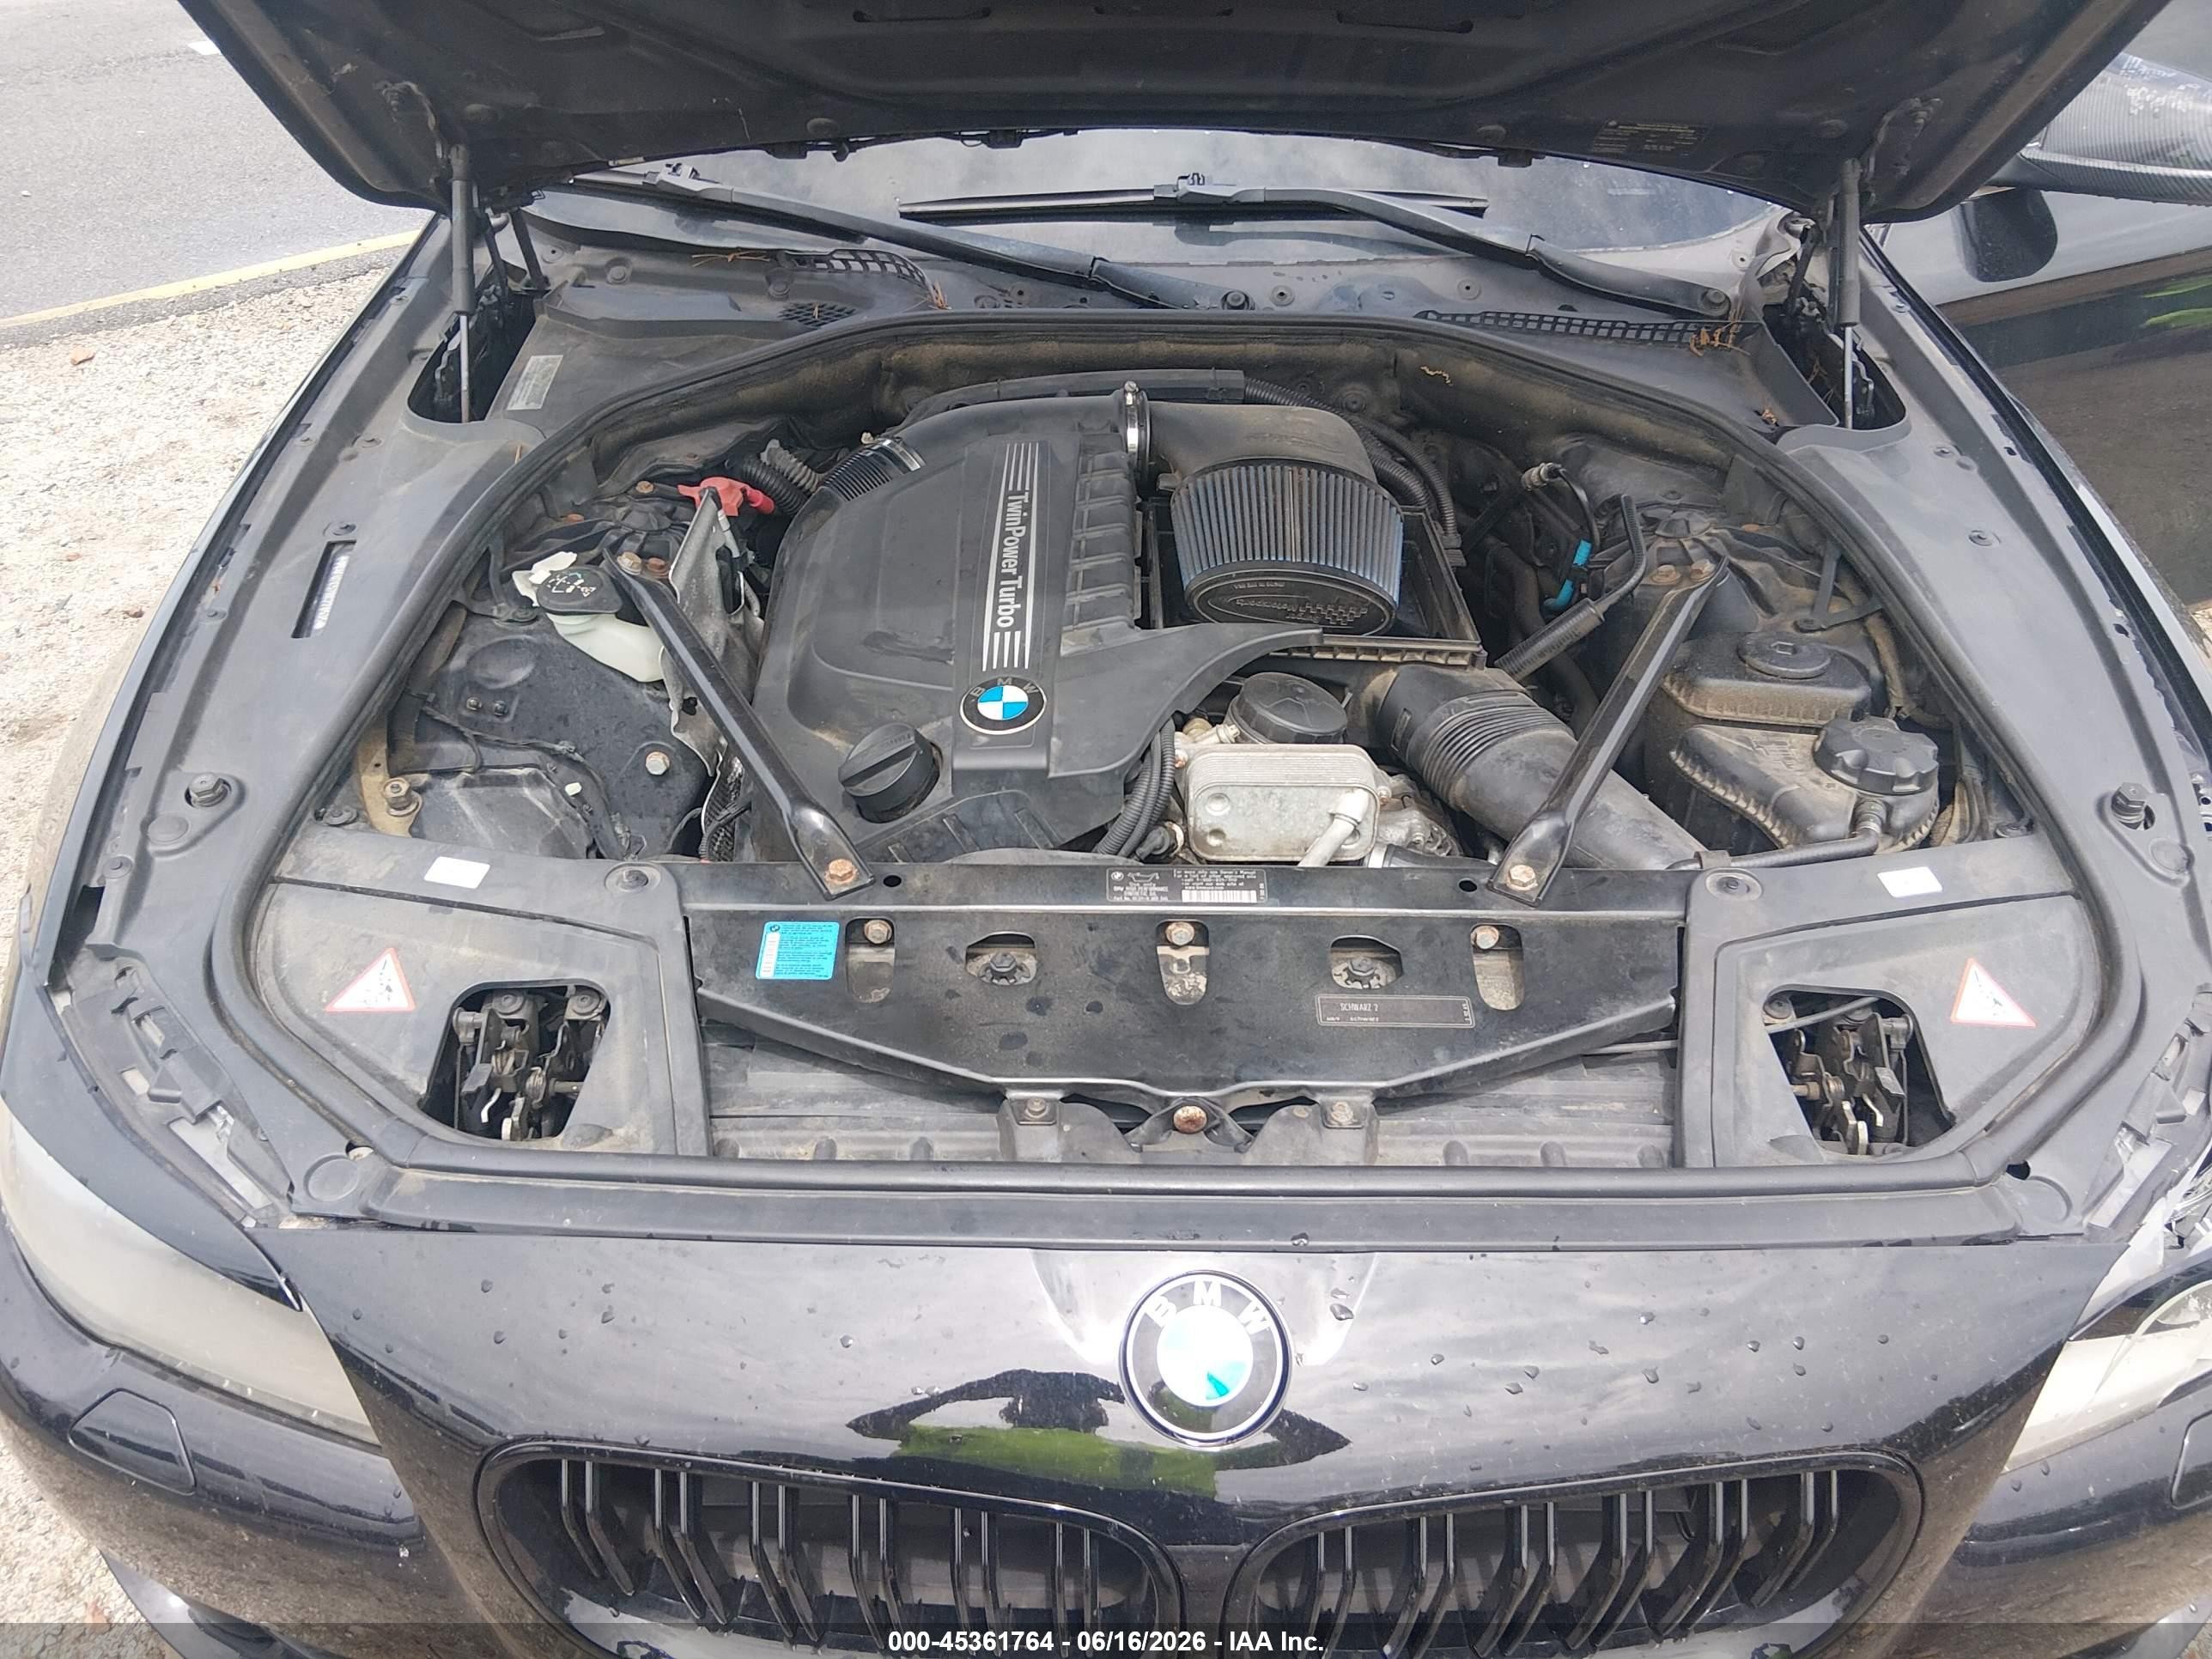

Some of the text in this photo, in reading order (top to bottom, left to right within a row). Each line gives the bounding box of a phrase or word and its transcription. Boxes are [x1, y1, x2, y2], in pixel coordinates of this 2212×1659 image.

[996, 490, 1030, 628] TwinPower Turbo
[970, 676, 1040, 697] BMW
[1340, 1002, 1379, 1012] SCHWARZ 2
[1144, 1280, 1272, 1335] BMW
